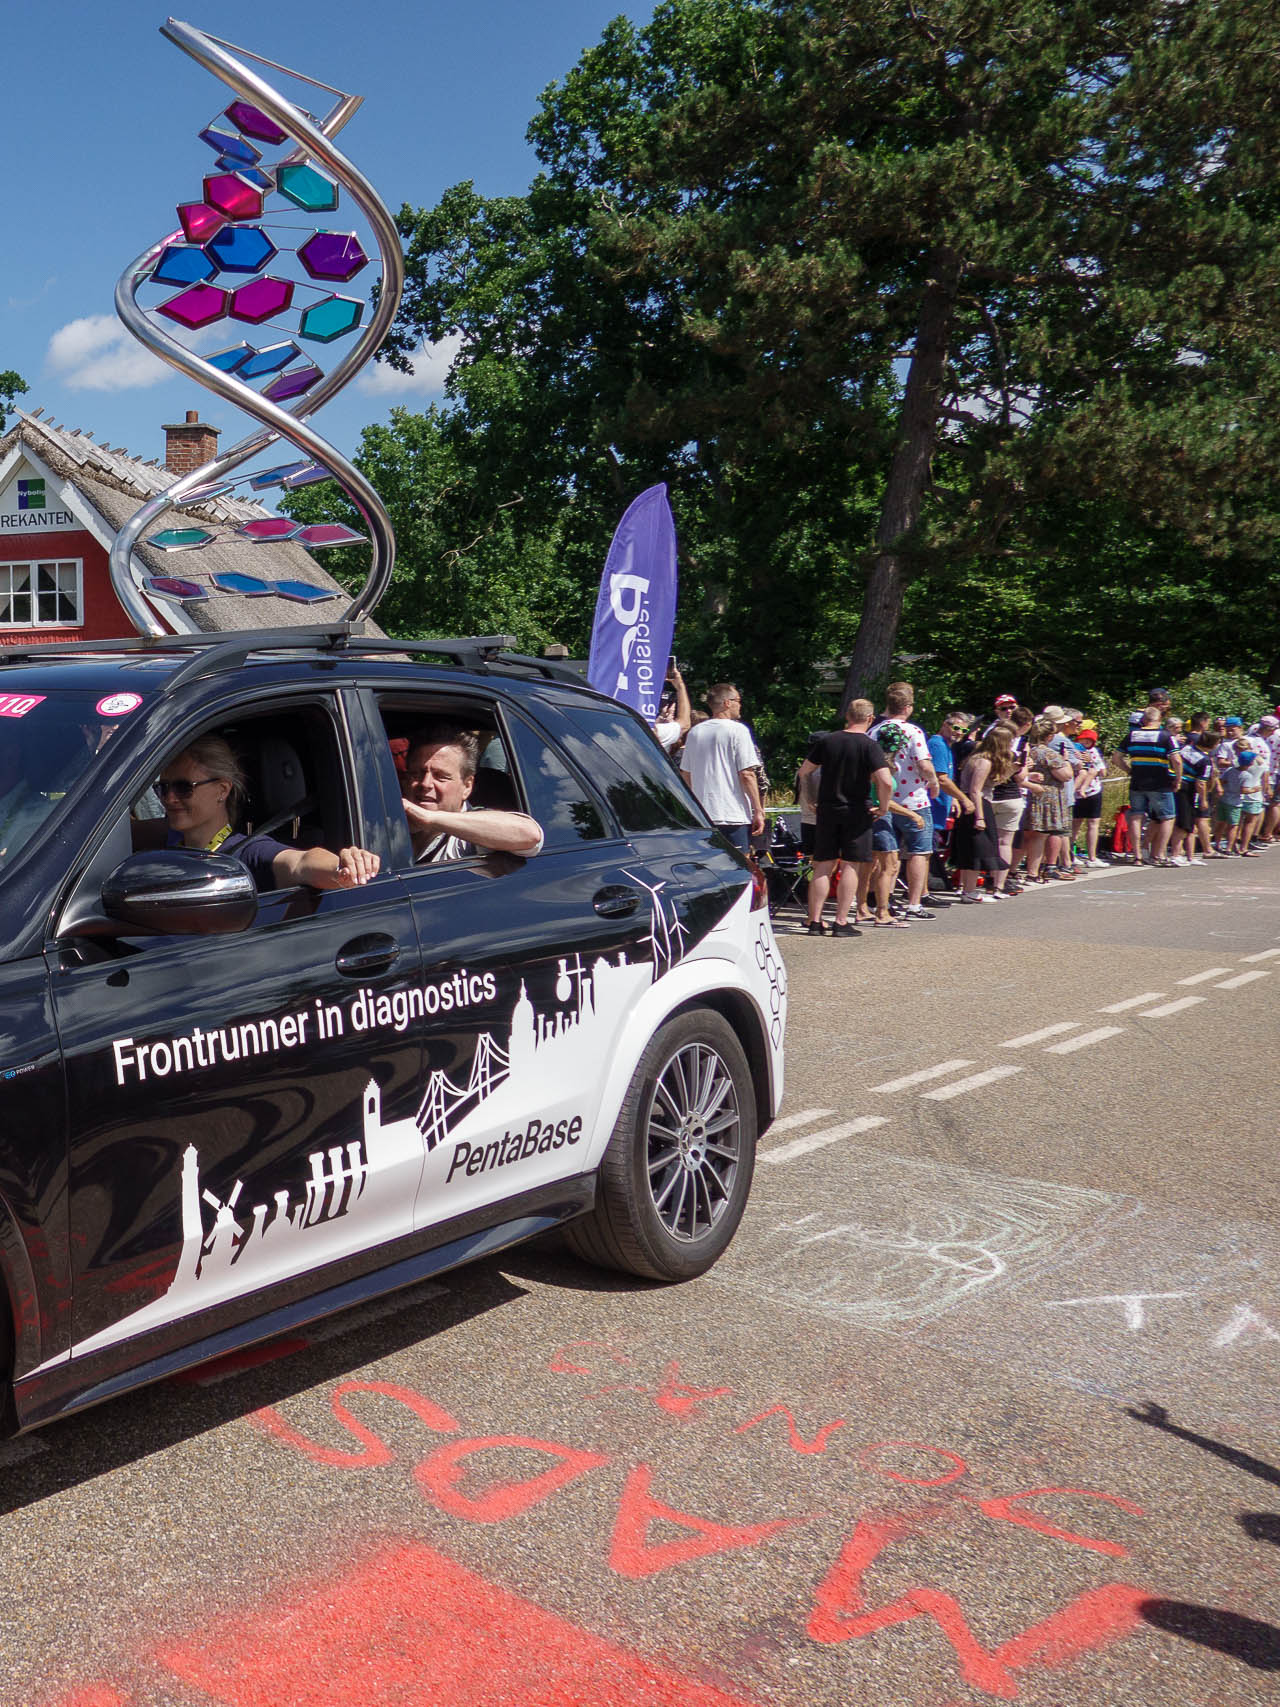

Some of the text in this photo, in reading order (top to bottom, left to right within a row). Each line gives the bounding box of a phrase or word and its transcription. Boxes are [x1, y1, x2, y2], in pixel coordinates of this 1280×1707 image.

[113, 969, 497, 1085] Frontrunner in diagnostics
[445, 1114, 583, 1184] PentaBase
